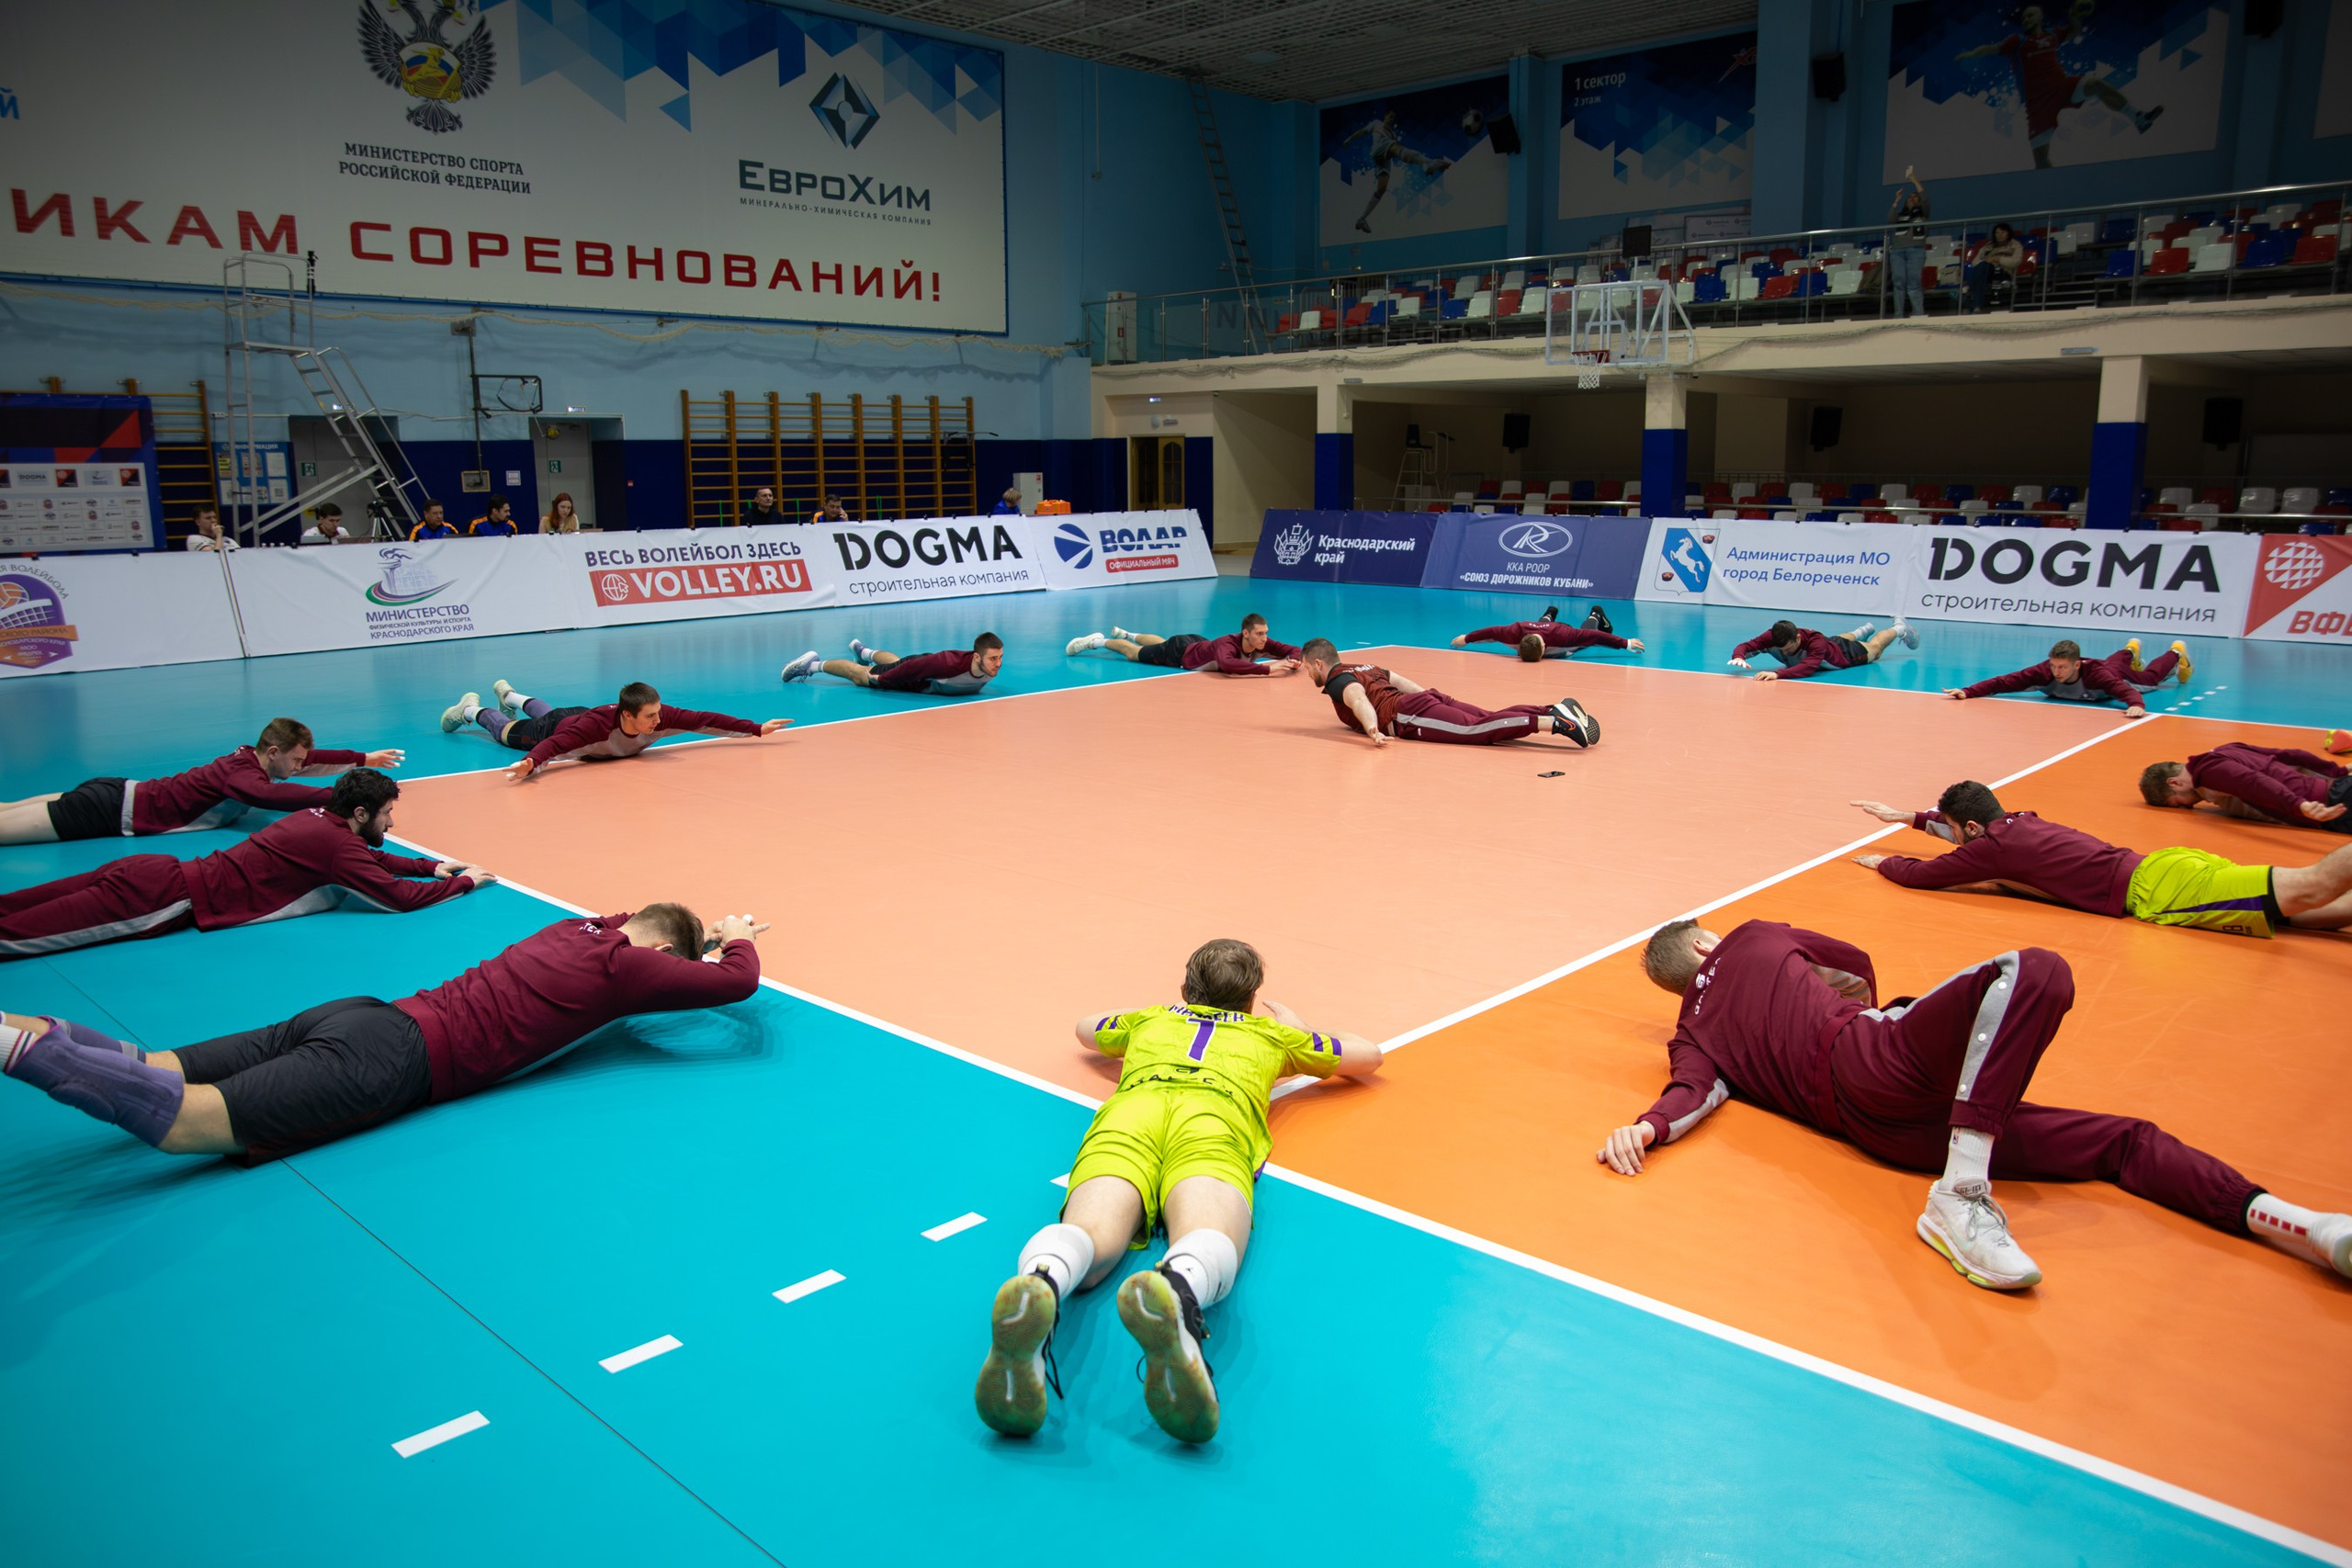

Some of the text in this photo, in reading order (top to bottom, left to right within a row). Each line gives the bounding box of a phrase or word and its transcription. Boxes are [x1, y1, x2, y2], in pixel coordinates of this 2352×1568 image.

[1575, 71, 1626, 91] 1 сектор
[1574, 95, 1601, 107] 2 этаж
[345, 142, 524, 175] МИНИСТЕРСТВО СПОРТА
[339, 161, 531, 194] РОССИЙСКОЙ ФЕДЕРАЦИИ
[740, 197, 932, 226] МИНЕРАЛЬНО-ХИМИЧЕСКАЯ КОМПАНИЯ
[350, 221, 940, 302] СОРЕВНОВАНИЙ!
[832, 525, 1023, 570] DOGMA
[1318, 535, 1415, 552] Краснодарский
[585, 541, 801, 567] ВЕСЬ ВОЛЕЙБОЛ ЗДЕСЬ
[1109, 557, 1175, 570] ОФИЦИАЛЬНЫЙ МЯЧ
[1314, 551, 1345, 566] край
[1726, 547, 1890, 566] Администрация МО
[1928, 536, 2220, 592] DOGMA
[1507, 562, 1550, 573] ККА РООР
[1723, 568, 1880, 586] город Белореченск
[10, 564, 69, 600] ВОЛЕЙБОЛА
[630, 563, 802, 598] VOLLEY.RU
[849, 570, 1029, 597] строительная компания
[1460, 572, 1593, 589] «СОЮЗ ДОРОЖНИКОВ КУБАНИ»
[366, 604, 469, 623] МИНИСТЕРСТВО
[1921, 592, 2215, 623] строительная компания
[369, 621, 411, 630] ФИЗИЧЕСКОЙ
[411, 618, 442, 627] КУЛЬТУРЫ
[370, 624, 474, 639] КРАСНОДАРСКОГО КРАЯ
